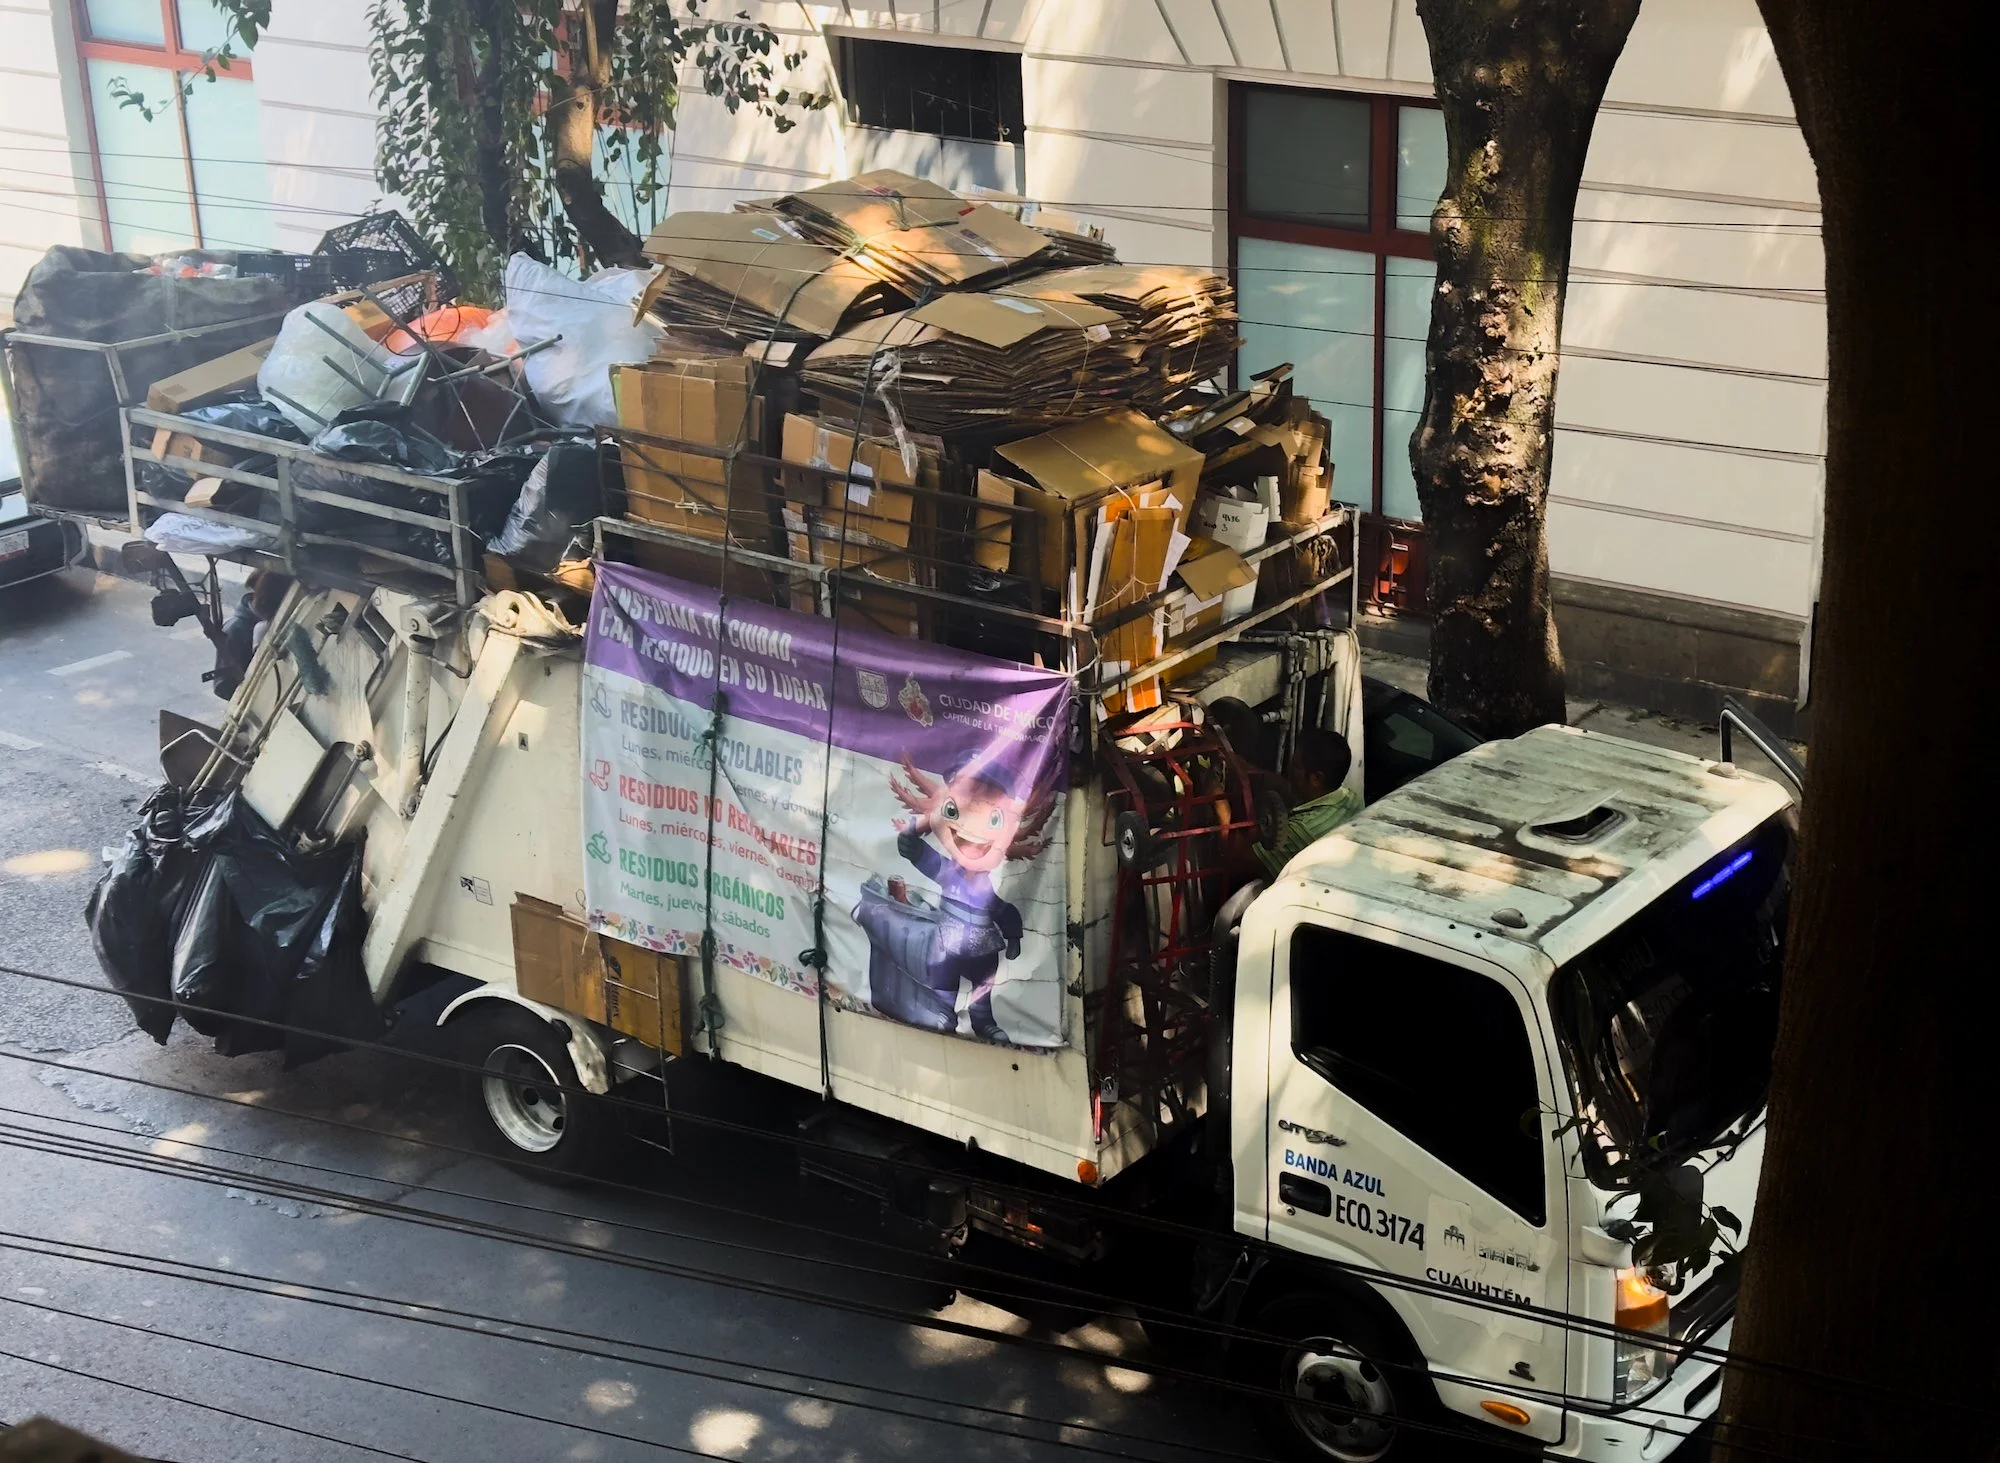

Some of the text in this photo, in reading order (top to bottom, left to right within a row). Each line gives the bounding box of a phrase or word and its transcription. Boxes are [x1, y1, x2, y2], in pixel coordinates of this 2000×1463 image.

[728, 619, 798, 669] CIUDAD,
[719, 654, 740, 686] EN
[744, 661, 767, 692] SU
[770, 669, 828, 712] LUGAR
[939, 694, 992, 715] CIUDAD
[994, 703, 1012, 721] DE
[943, 711, 970, 726] CAPITAL
[971, 718, 983, 729] DE
[983, 722, 993, 732] LA
[622, 734, 661, 761] Lunes,
[732, 779, 767, 805] iernes
[718, 736, 803, 787] CICLABLES
[619, 774, 698, 815] RESIDUOS
[619, 807, 657, 835] Lunes,
[661, 821, 727, 852] miércoes,
[619, 847, 699, 889] RESIDUOS
[620, 881, 664, 908] Martes,
[722, 909, 771, 939] sábados
[1285, 1149, 1386, 1198] BANDA AZUL
[1336, 1194, 1425, 1252] ECO.3174
